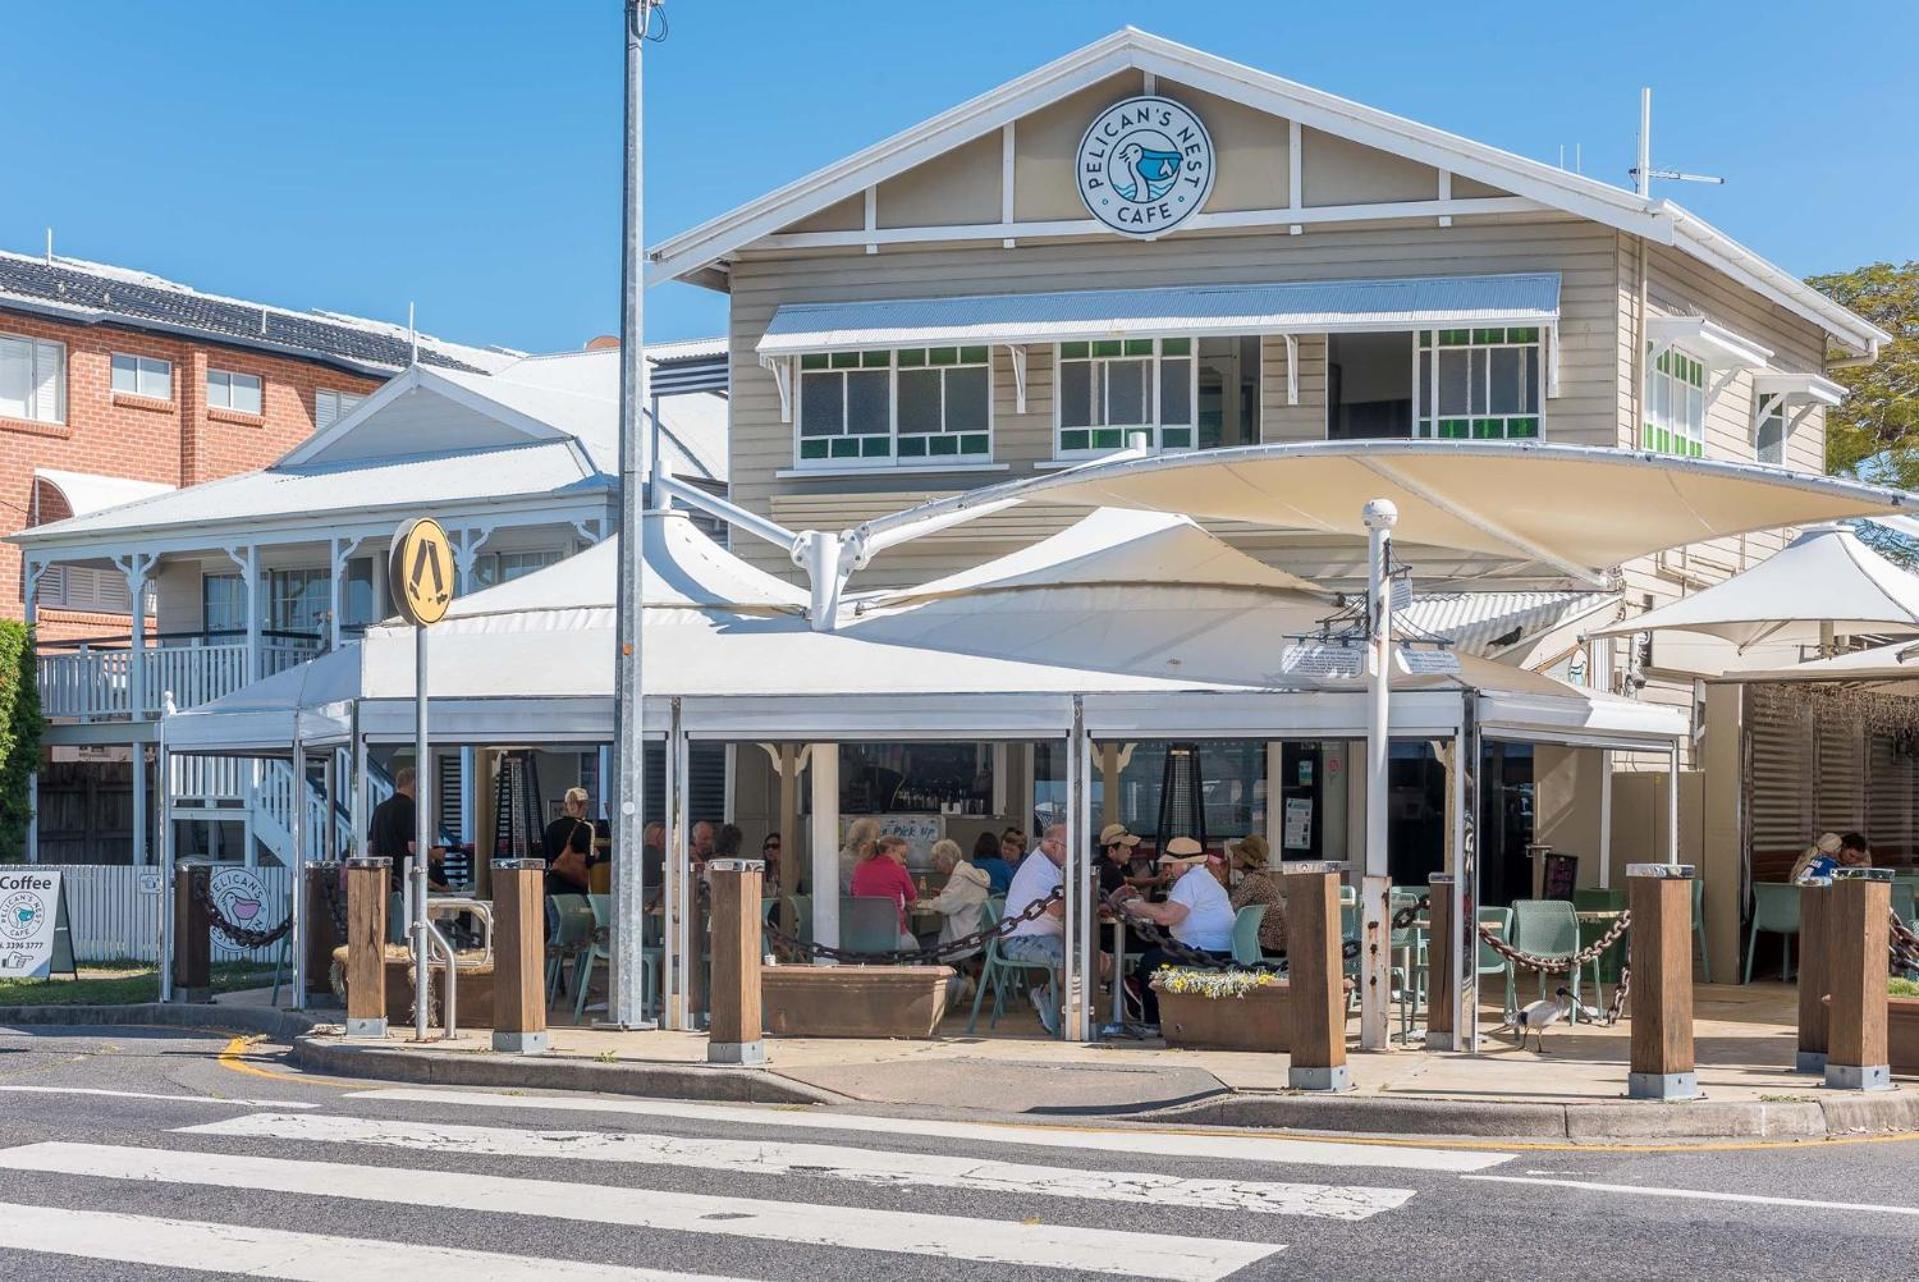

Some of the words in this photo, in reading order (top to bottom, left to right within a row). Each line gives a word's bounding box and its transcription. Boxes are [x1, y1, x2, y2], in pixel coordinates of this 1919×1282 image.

[1086, 107, 1172, 190] PELICAN'S
[1177, 127, 1202, 188] NEST
[1117, 202, 1172, 224] CAFE
[0, 875, 52, 890] Coffee
[212, 874, 263, 899] ELICAN'S
